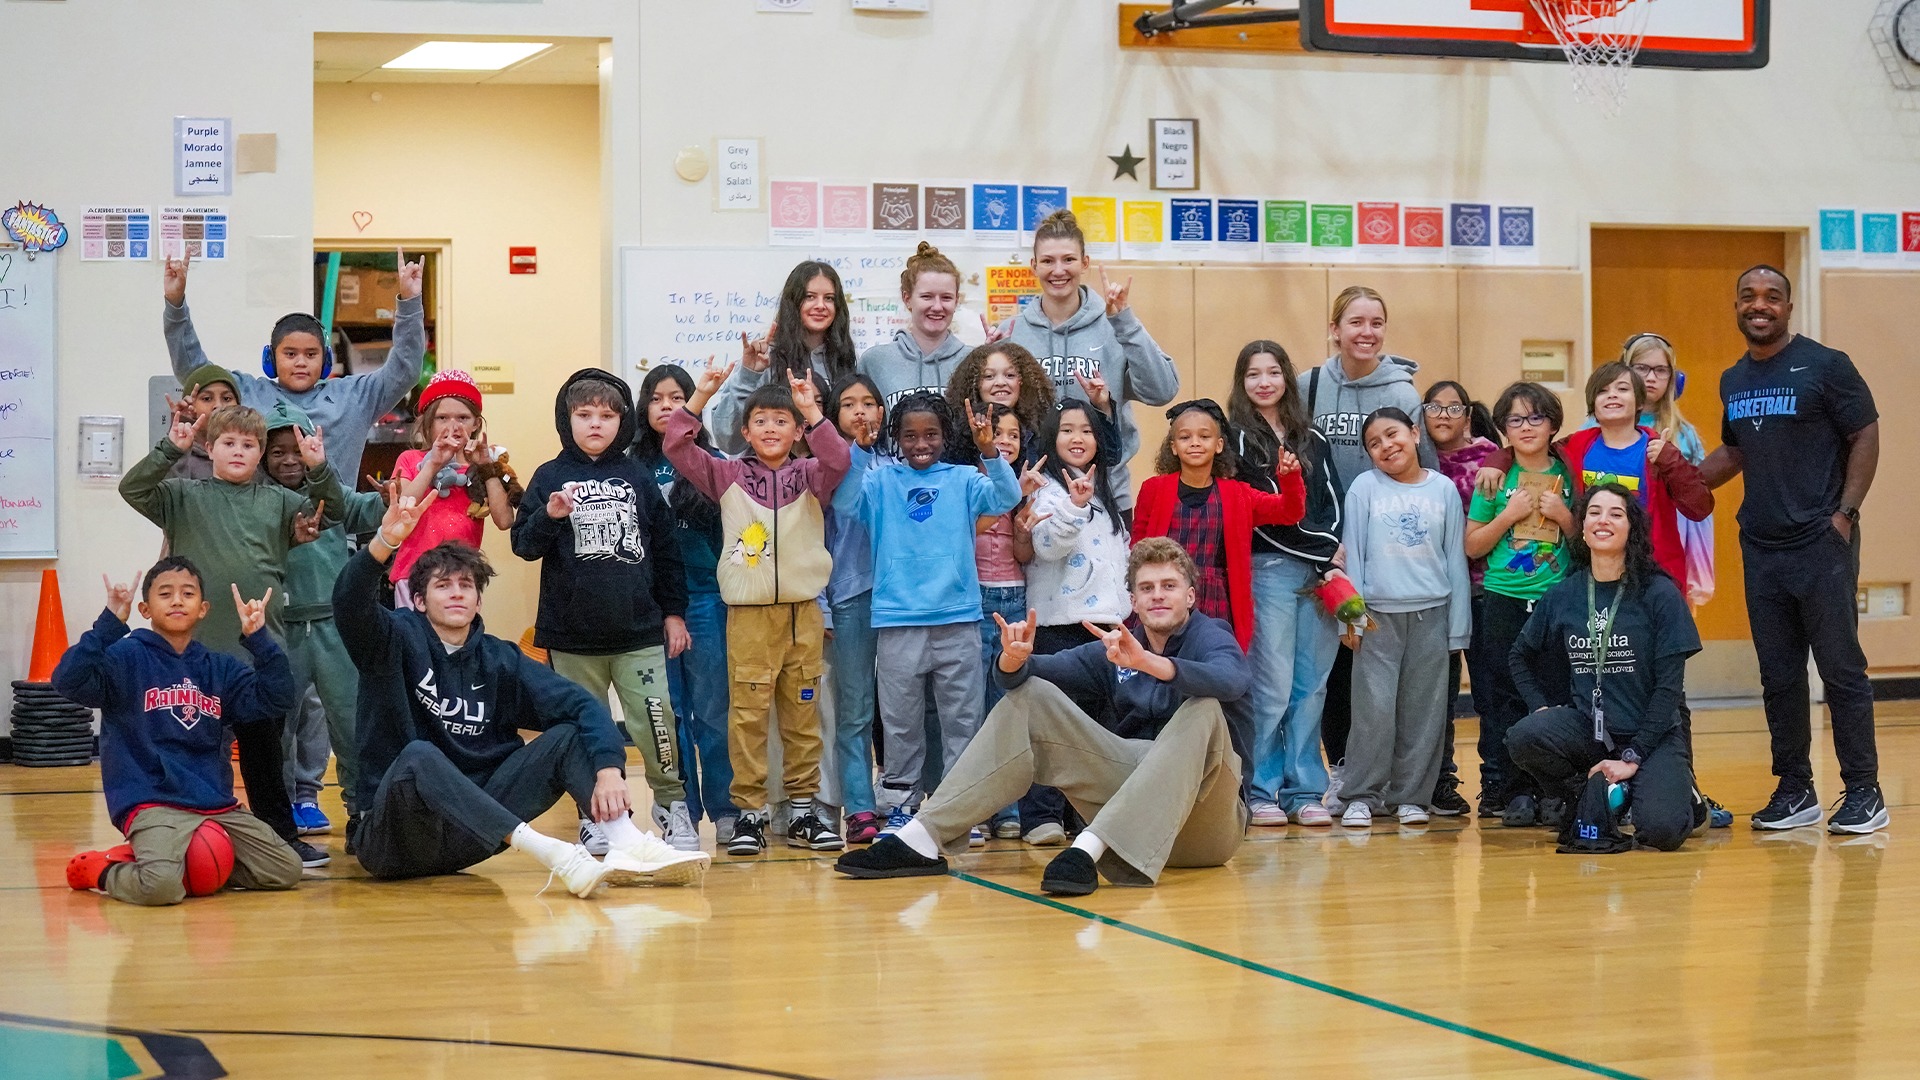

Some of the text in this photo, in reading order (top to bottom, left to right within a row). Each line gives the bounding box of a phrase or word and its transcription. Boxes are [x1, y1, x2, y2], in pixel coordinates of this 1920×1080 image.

[187, 127, 219, 137] Purple
[184, 143, 223, 151] Morado
[728, 146, 749, 156] Grey
[1162, 142, 1188, 152] Negro
[185, 159, 222, 168] Jamnee
[730, 161, 748, 170] Gris
[726, 176, 752, 186] Salati
[7, 210, 64, 246] FANTASTIC!
[990, 268, 1004, 279] PE
[727, 292, 747, 308] like
[858, 297, 899, 314] Thursday
[675, 309, 766, 324] we do have
[1728, 395, 1797, 421] BASKETBALL
[576, 502, 613, 512] RECORDS
[645, 696, 674, 774] MINECRAFT
